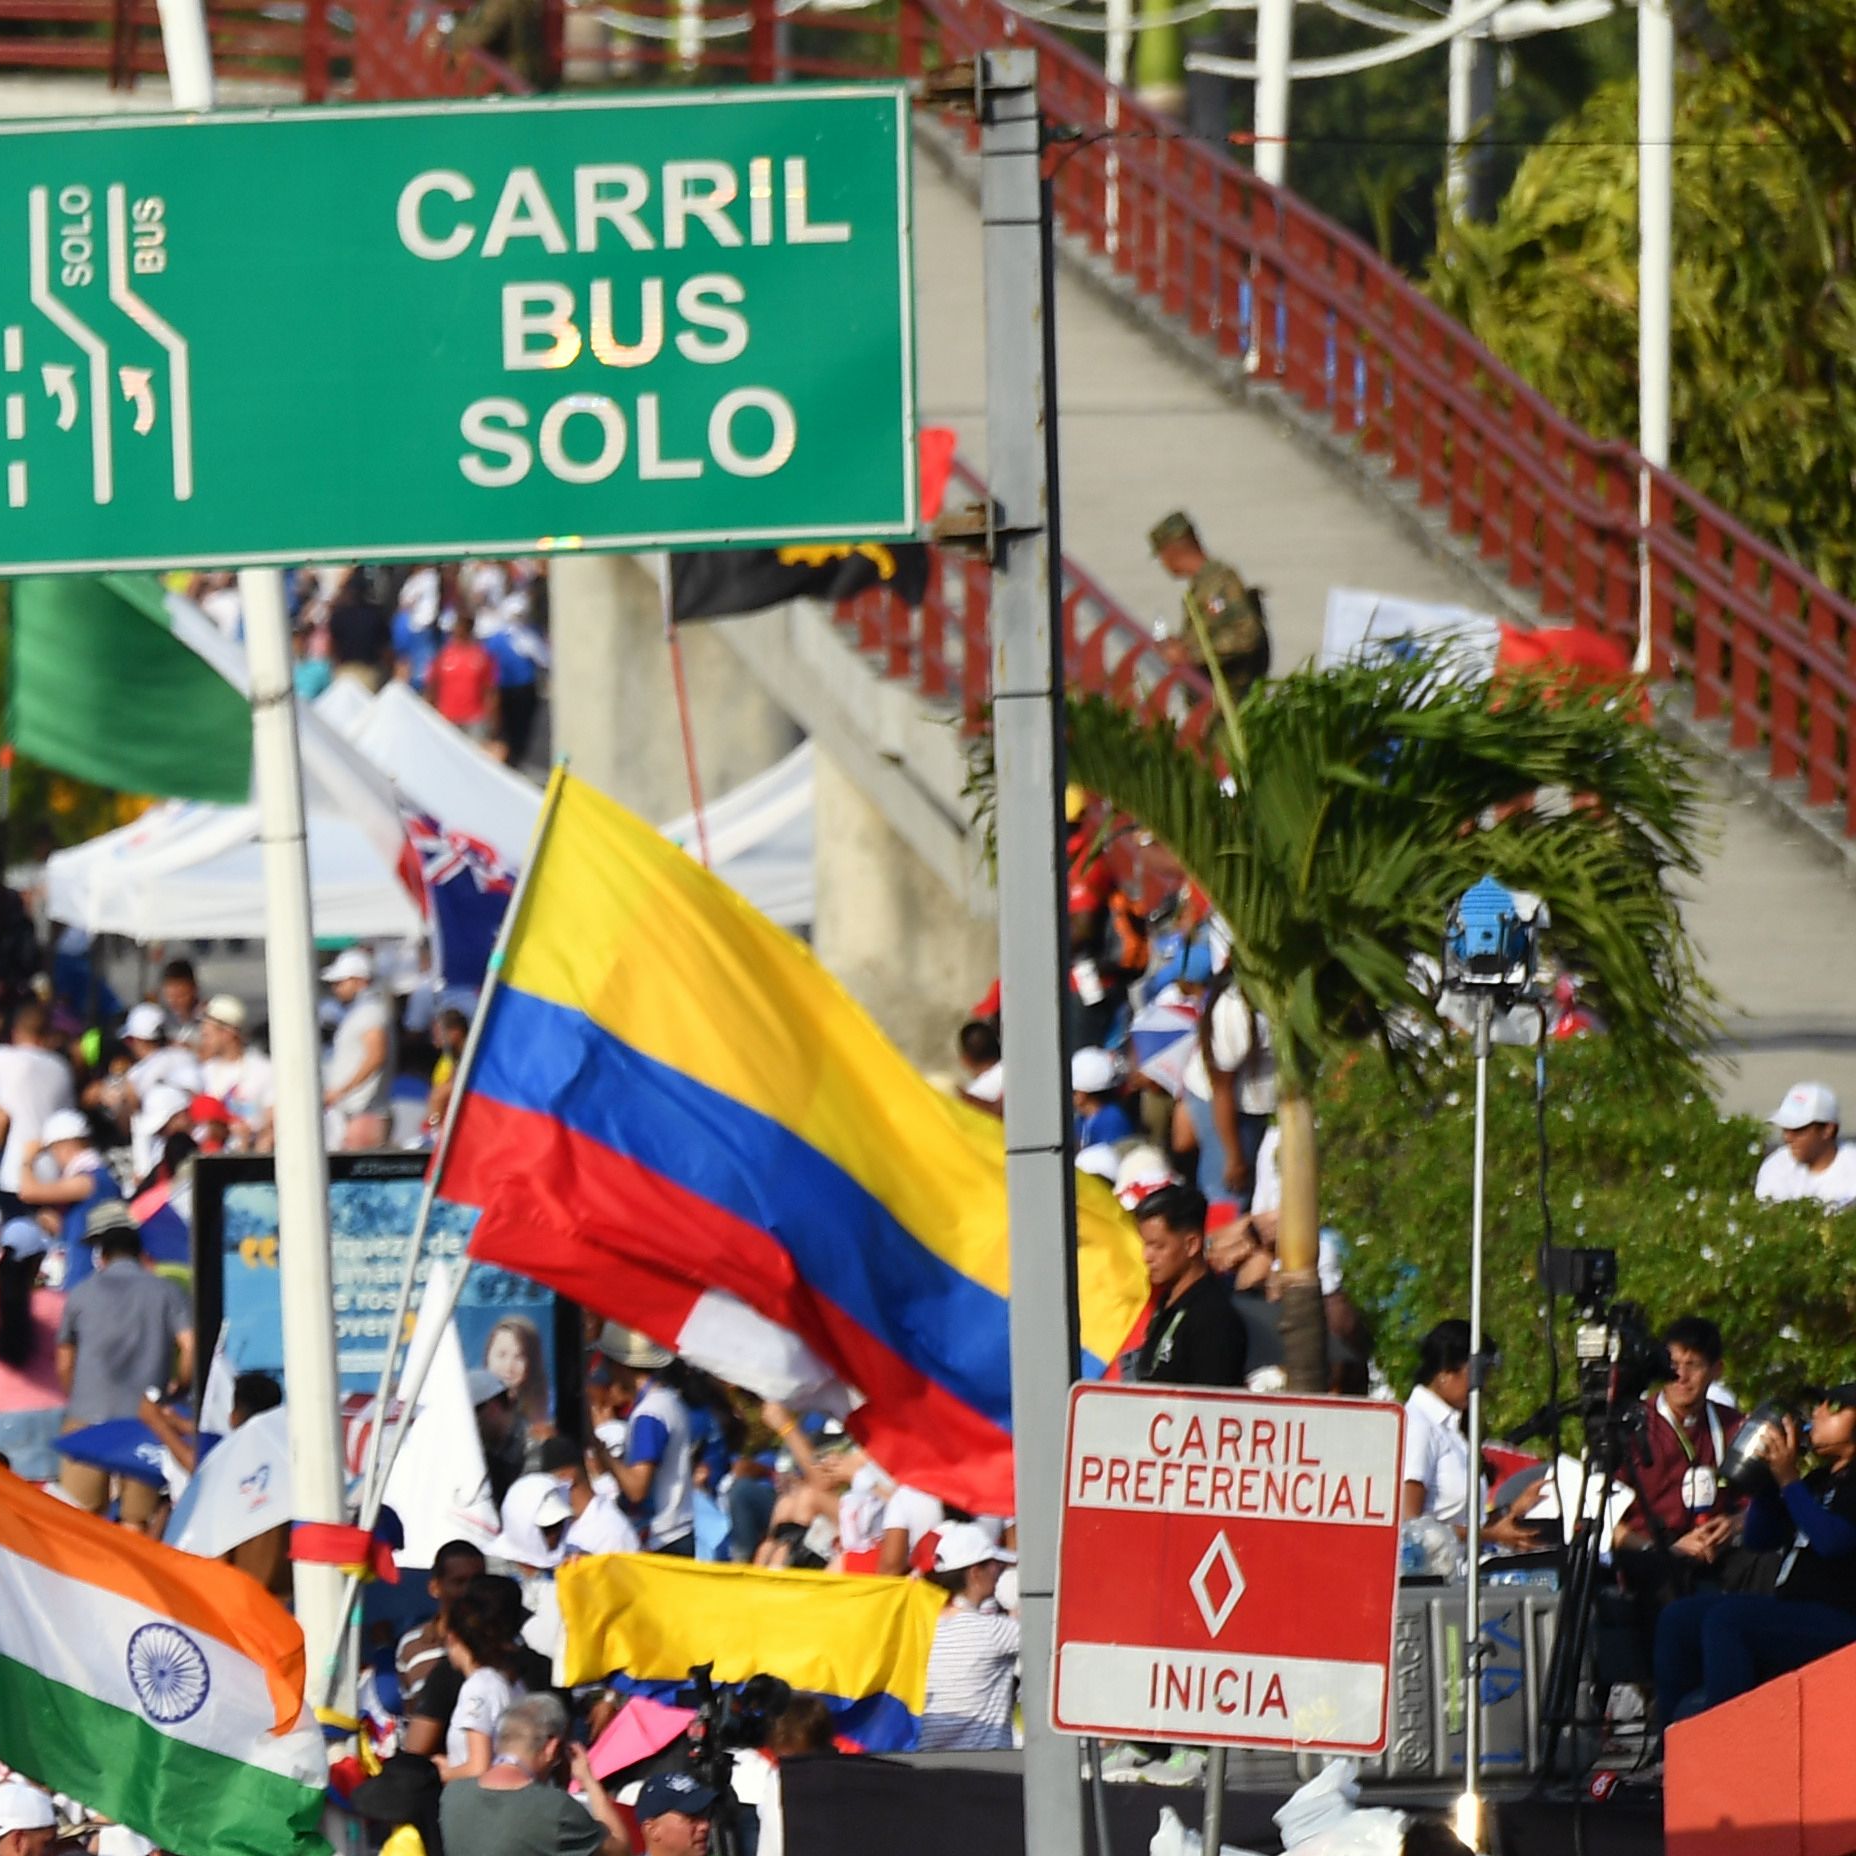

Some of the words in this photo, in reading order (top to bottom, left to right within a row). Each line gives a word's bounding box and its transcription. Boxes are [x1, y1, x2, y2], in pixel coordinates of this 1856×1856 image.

[59, 185, 94, 288] SOLO
[132, 196, 166, 276] BUS
[395, 155, 852, 262] CARRIL
[500, 273, 750, 374] BUS
[458, 386, 798, 490] SOLO
[1148, 1413, 1322, 1468] CARRIL
[1079, 1456, 1388, 1522] PREFERENCIAL
[1147, 1663, 1291, 1724] INICIA
